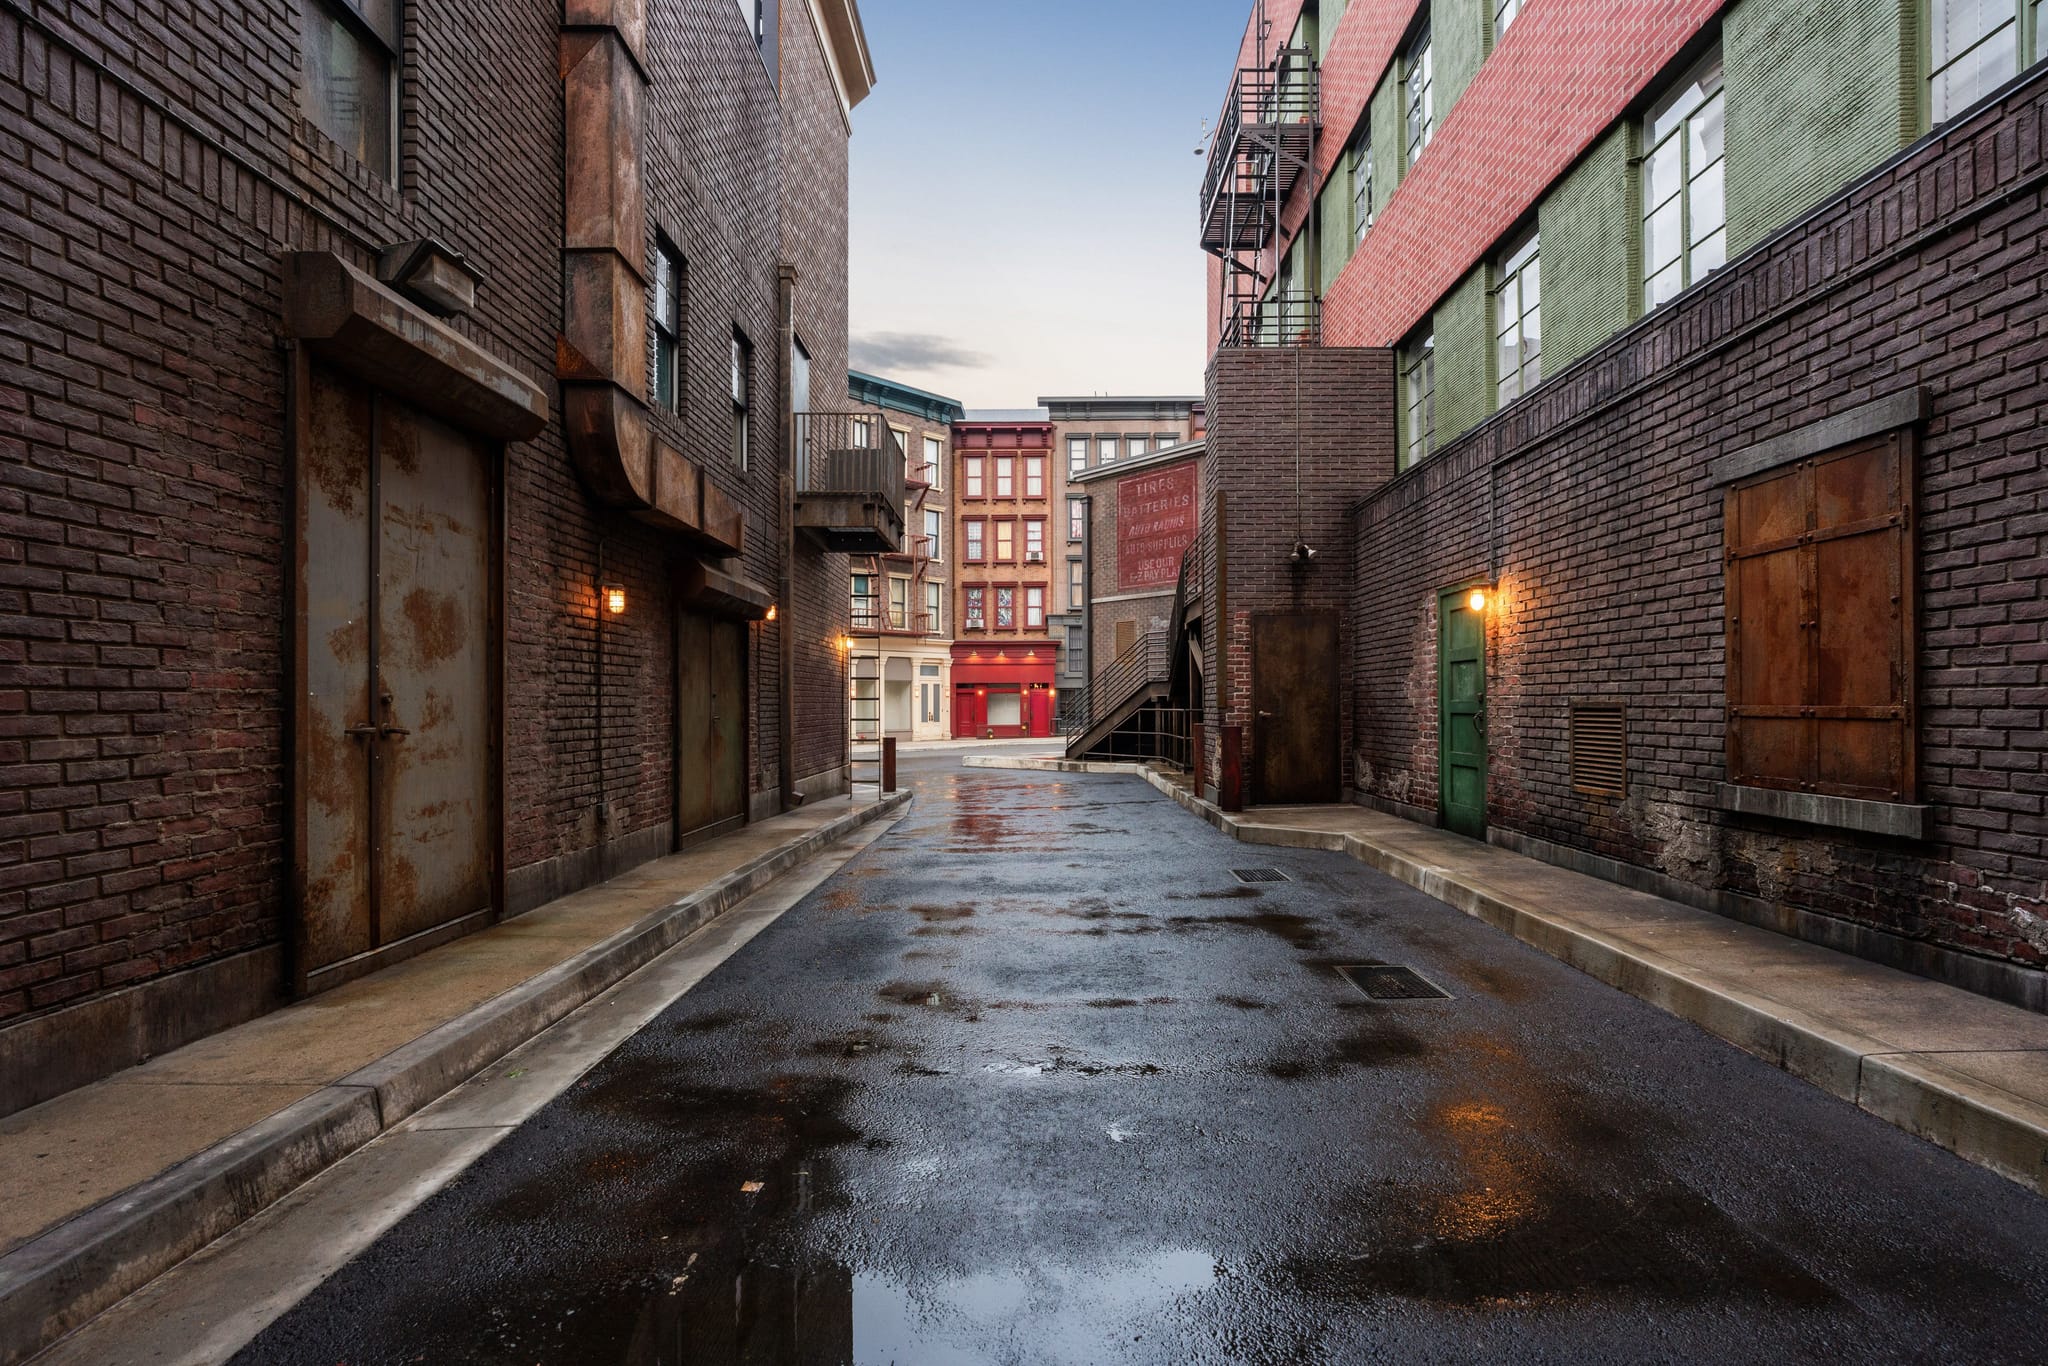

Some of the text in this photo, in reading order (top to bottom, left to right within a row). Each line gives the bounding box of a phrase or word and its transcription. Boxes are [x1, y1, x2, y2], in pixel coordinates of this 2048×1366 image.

[1136, 478, 1174, 496] TIRES
[1123, 495, 1189, 517] BATTERIES
[1129, 523, 1150, 537] AUTO
[1125, 542, 1145, 555] AUTO
[1139, 556, 1174, 571] USE OUR
[1144, 568, 1160, 581] PAY
